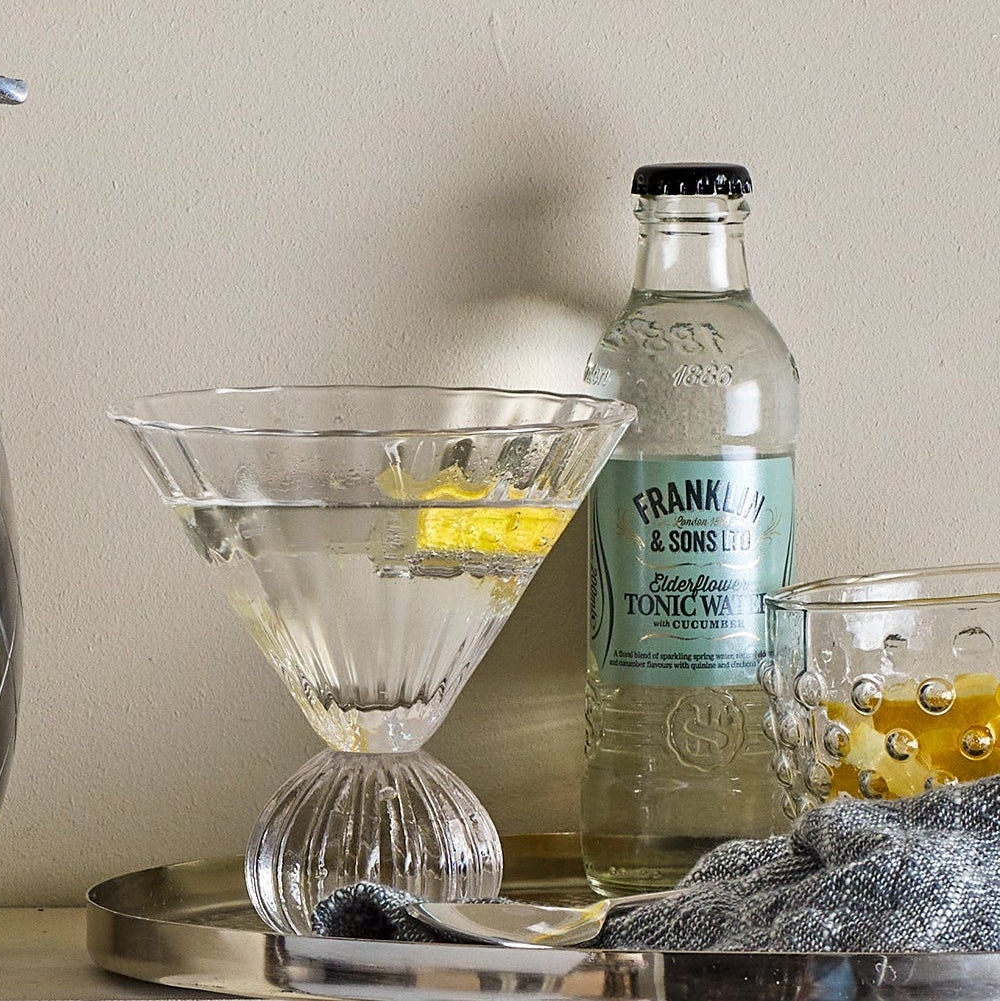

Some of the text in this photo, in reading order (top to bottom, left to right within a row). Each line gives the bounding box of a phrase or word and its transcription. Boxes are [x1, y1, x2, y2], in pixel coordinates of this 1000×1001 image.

[632, 479, 766, 526] FRANKLIN
[672, 515, 708, 530] London
[650, 529, 751, 553] & SONS LTD
[649, 572, 750, 597] Elderflower
[624, 592, 697, 616] TONIC
[653, 619, 745, 629] with CUCUMBER
[660, 652, 692, 662] sparkling
[693, 652, 715, 662] spring
[673, 661, 690, 669] with
